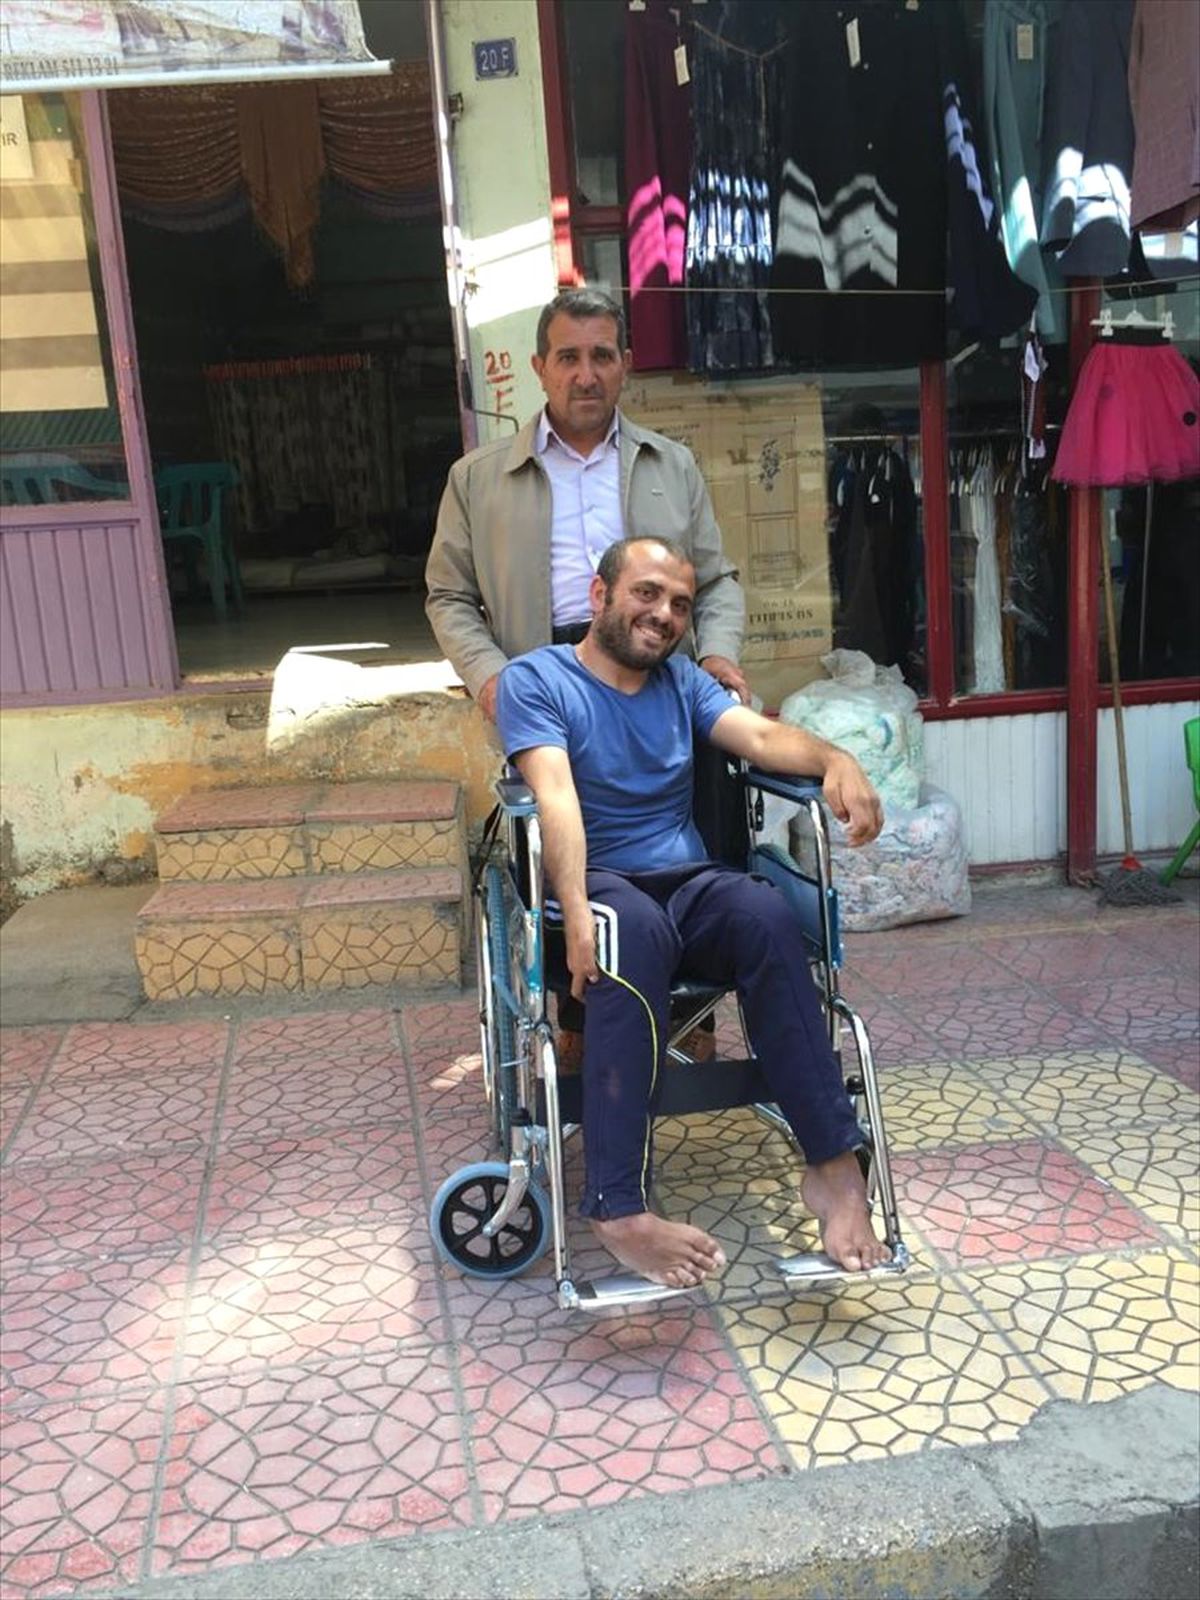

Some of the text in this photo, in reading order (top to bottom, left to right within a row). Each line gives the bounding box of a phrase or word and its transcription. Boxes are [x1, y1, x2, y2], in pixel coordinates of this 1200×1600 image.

[481, 47, 509, 71] 20 F
[485, 351, 512, 375] 20
